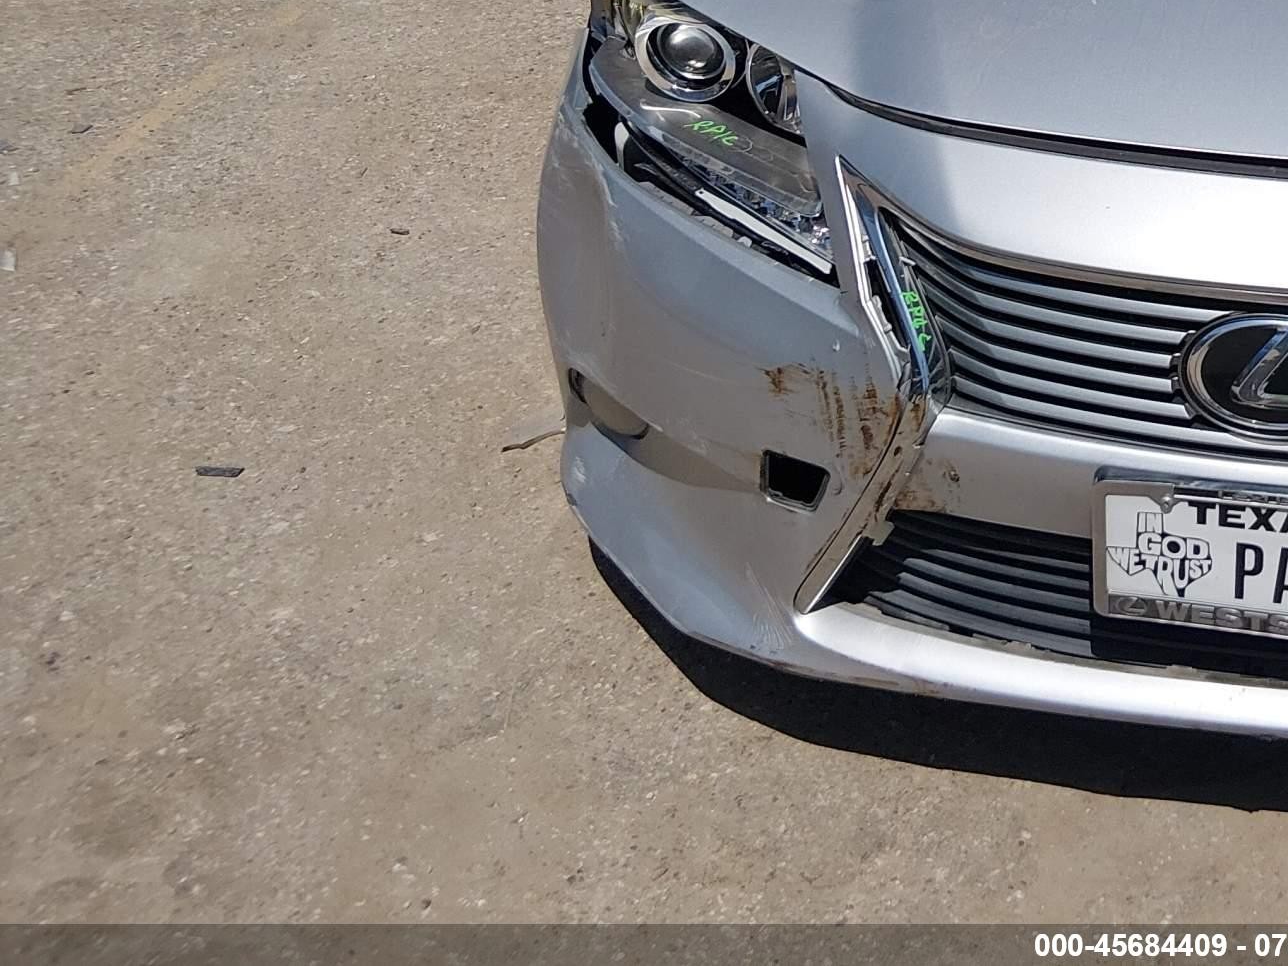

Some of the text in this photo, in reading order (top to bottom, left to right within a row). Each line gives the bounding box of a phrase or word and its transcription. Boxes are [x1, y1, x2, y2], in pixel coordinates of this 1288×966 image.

[1137, 512, 1163, 534] IN
[1137, 532, 1210, 560] GOD
[1106, 547, 1213, 596] WE TRUST
